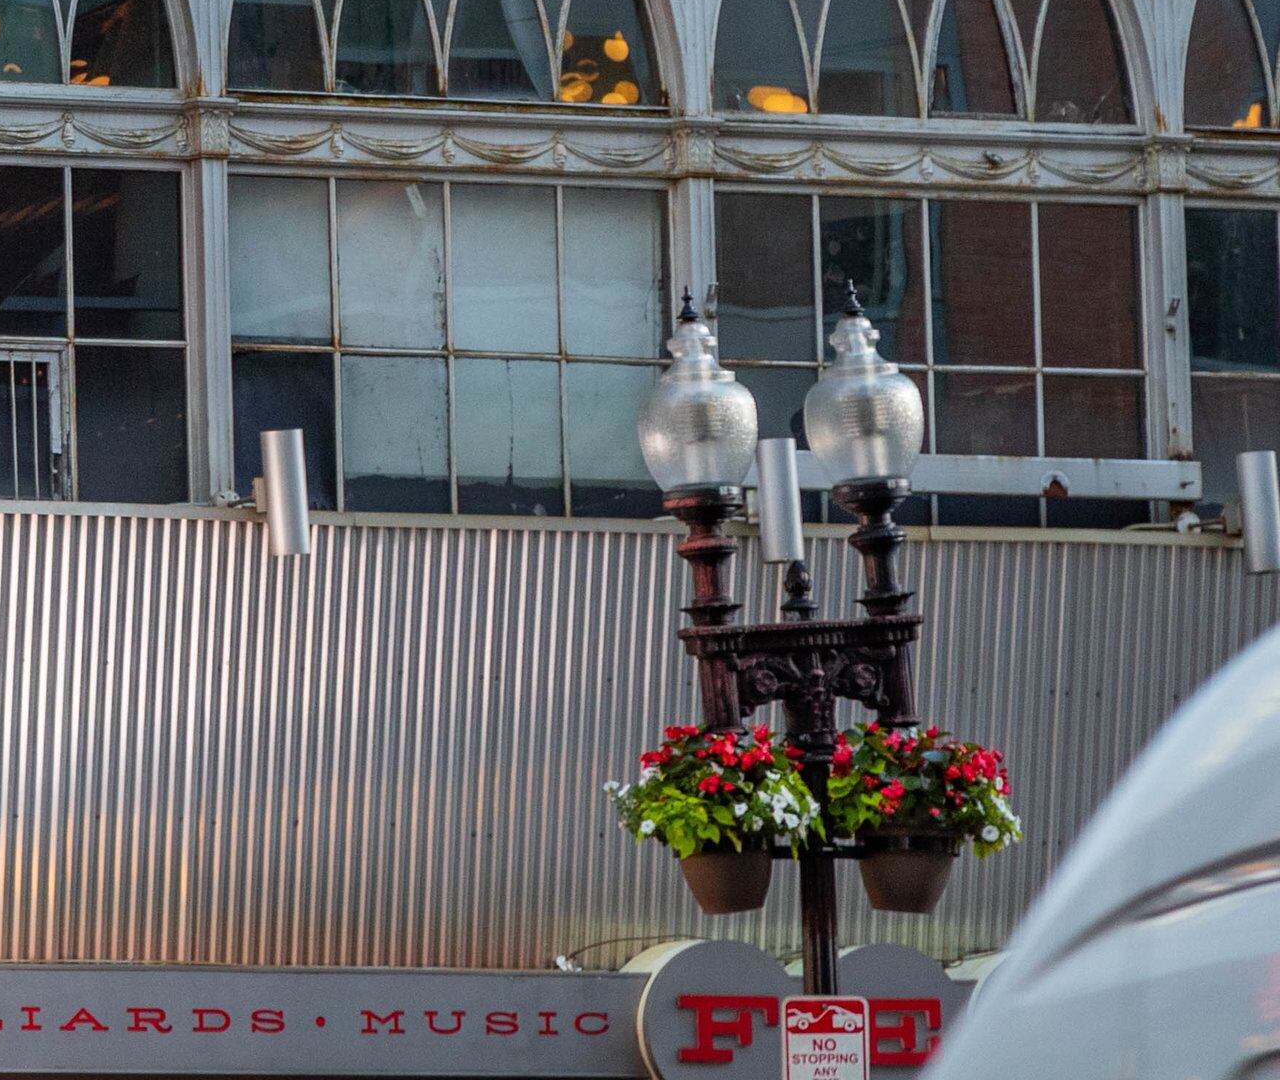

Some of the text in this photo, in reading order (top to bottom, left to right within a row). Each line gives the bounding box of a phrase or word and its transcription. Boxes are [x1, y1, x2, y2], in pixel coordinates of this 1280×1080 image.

[360, 1008, 612, 1037] MUSIC
[812, 1038, 837, 1051] NO
[792, 1053, 859, 1065] STOPPING
[814, 1067, 838, 1076] ANY
